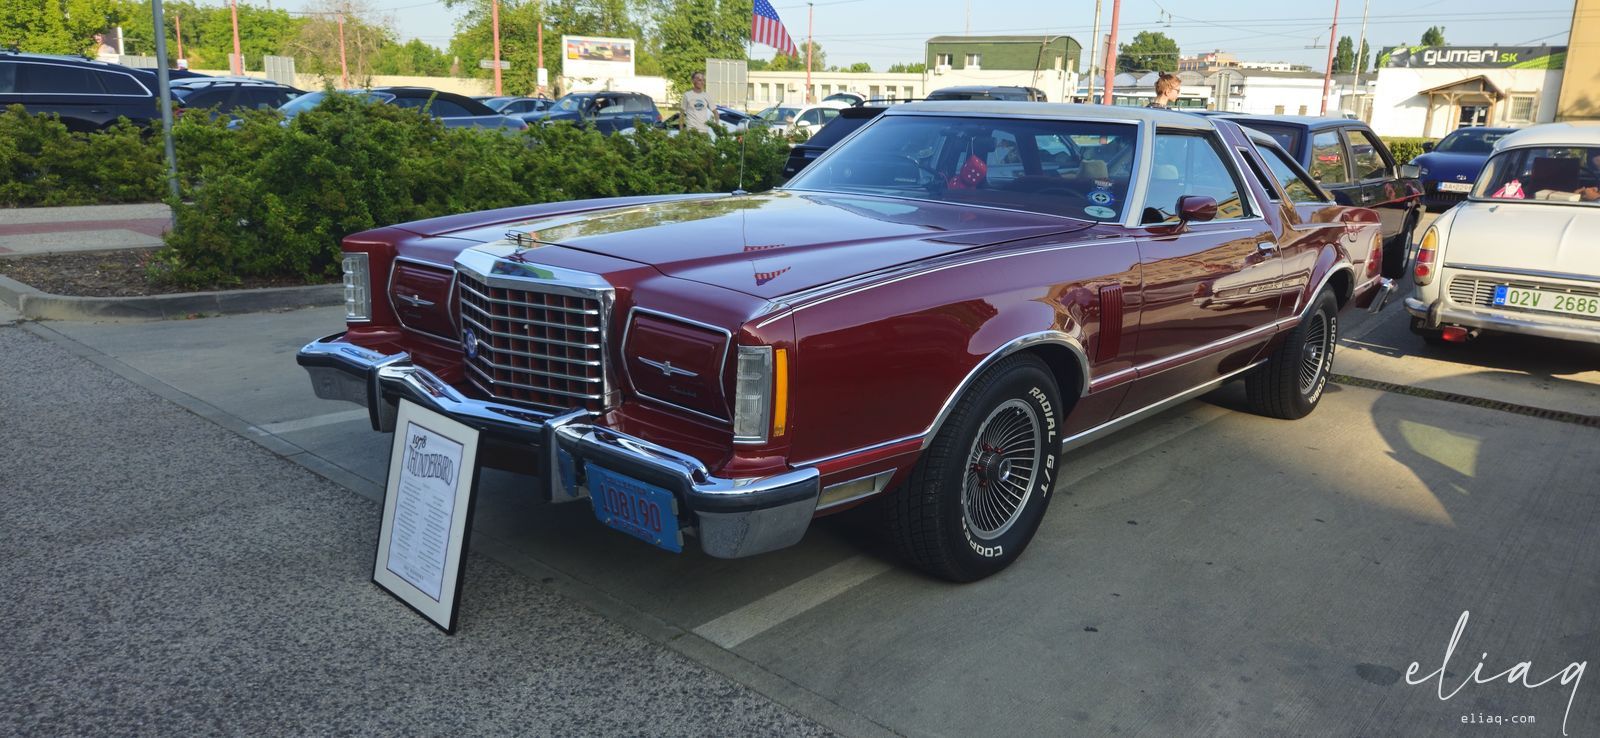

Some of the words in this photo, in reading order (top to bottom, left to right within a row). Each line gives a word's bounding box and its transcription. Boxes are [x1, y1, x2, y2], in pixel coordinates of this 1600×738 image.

[1509, 290, 1541, 307] 02V
[1553, 295, 1599, 314] 2686
[1308, 375, 1326, 404] COBRA
[1028, 386, 1057, 444] RADIAL
[412, 434, 428, 450] 1978
[407, 444, 454, 487] THUNDERBIRD
[1040, 454, 1055, 498] G/T
